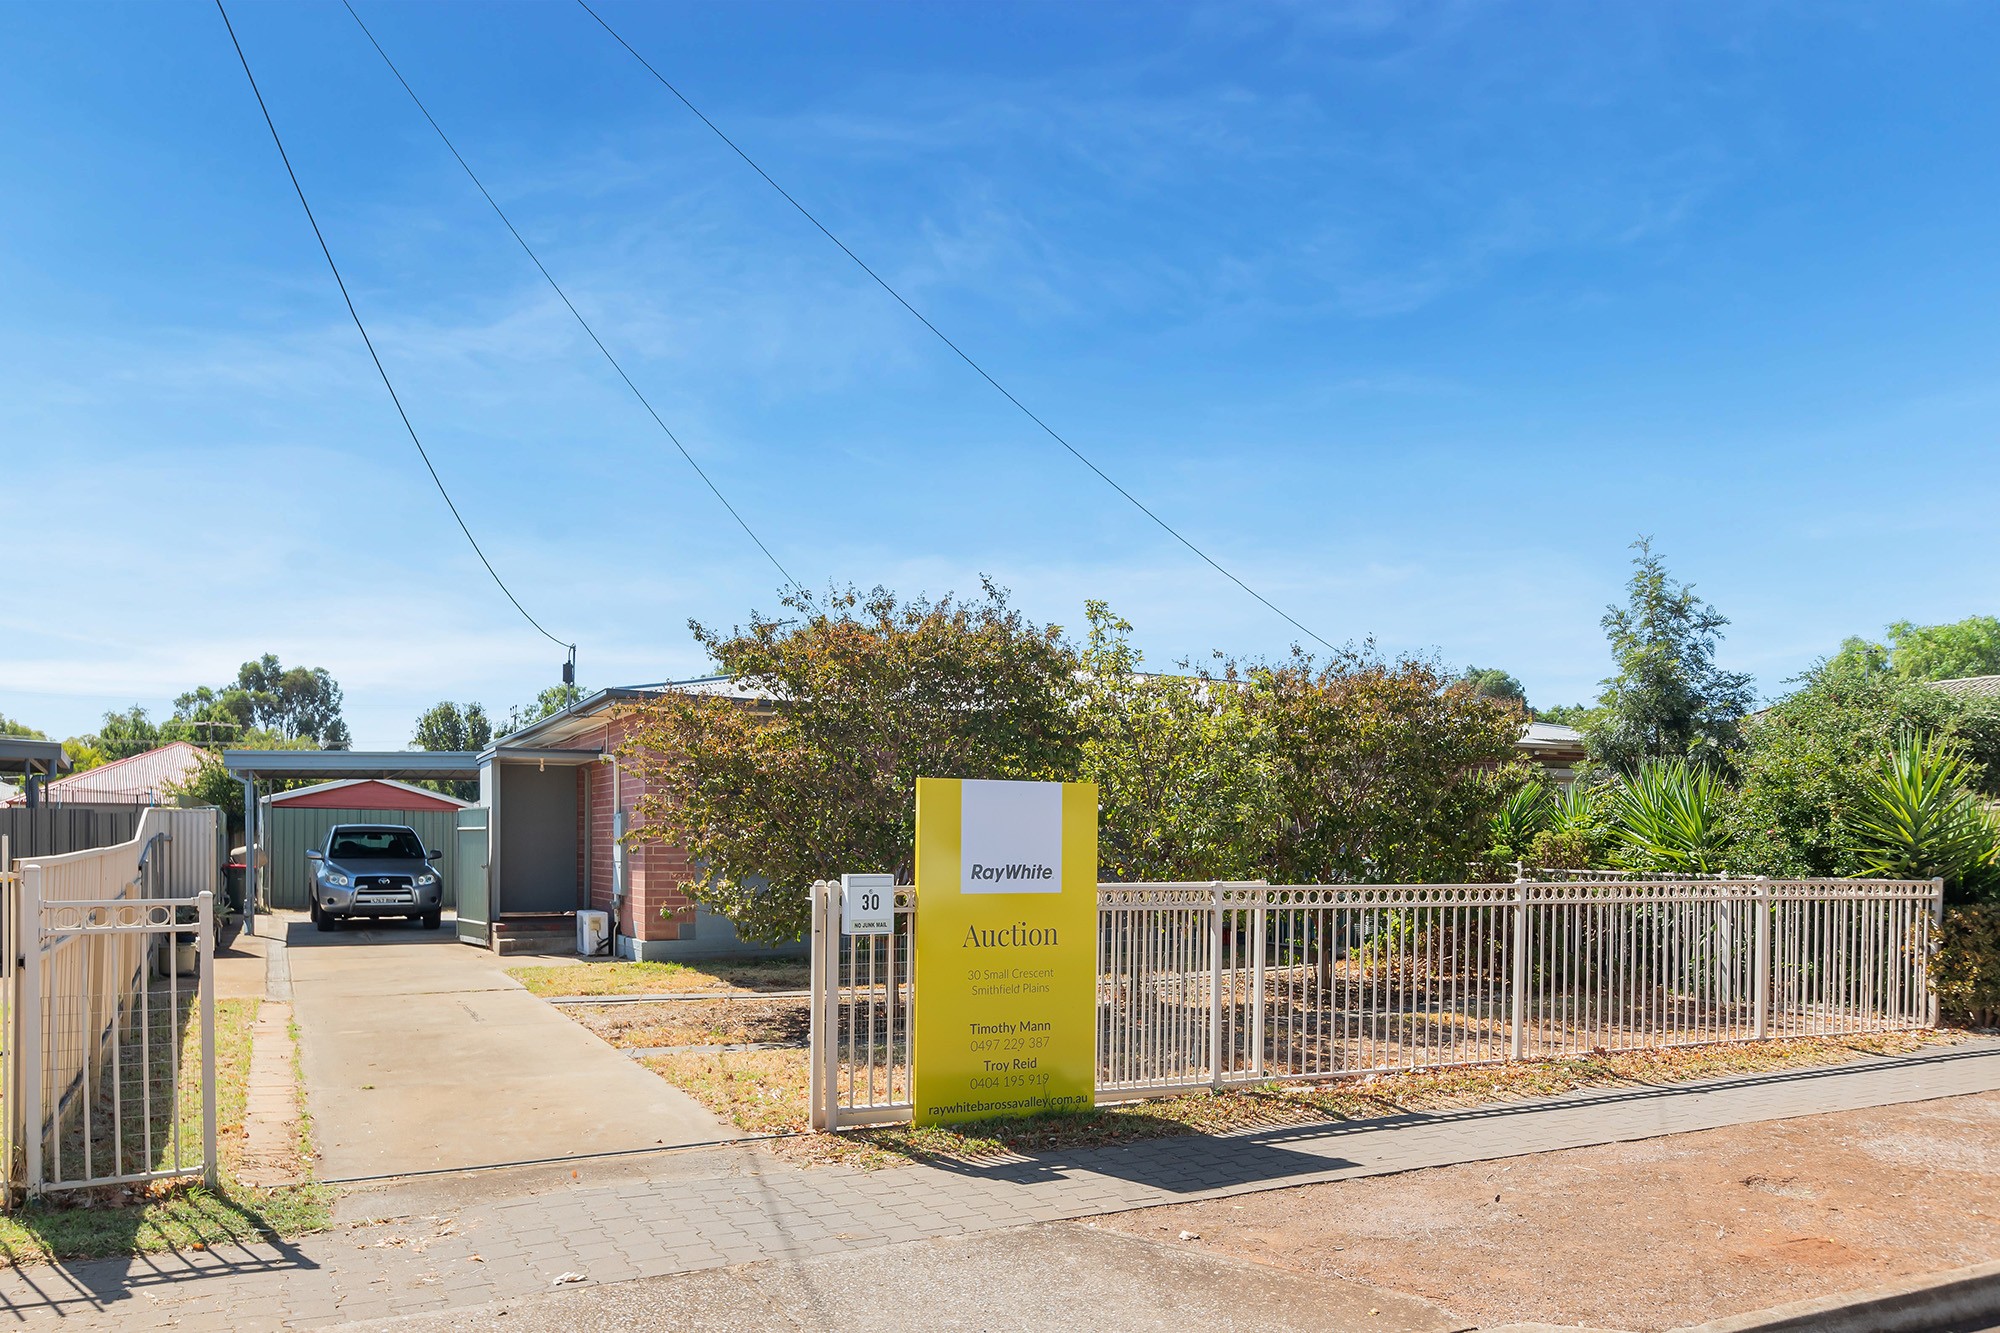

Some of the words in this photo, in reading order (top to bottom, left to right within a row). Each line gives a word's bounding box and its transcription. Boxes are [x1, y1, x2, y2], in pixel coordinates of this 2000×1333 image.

[862, 893, 880, 911] 30
[962, 921, 1058, 948] Auction
[967, 969, 981, 981] 30
[984, 969, 1009, 980] Small
[1011, 968, 1054, 979] Crescent
[971, 983, 1020, 996] Smithfield
[1022, 983, 1050, 994] Plains
[970, 1022, 1017, 1035] Timothy
[1020, 1020, 1051, 1032] Mann
[970, 1038, 1000, 1053] 0497
[1003, 1037, 1025, 1051] 229
[1028, 1036, 1050, 1049] 387
[984, 1060, 1010, 1073] Troy
[1013, 1057, 1037, 1070] Reid
[970, 1076, 1000, 1090] 0404
[1004, 1074, 1025, 1087] 195
[1028, 1073, 1050, 1086] 919
[928, 1094, 1088, 1117] raywhitebarossavalley.com.au
